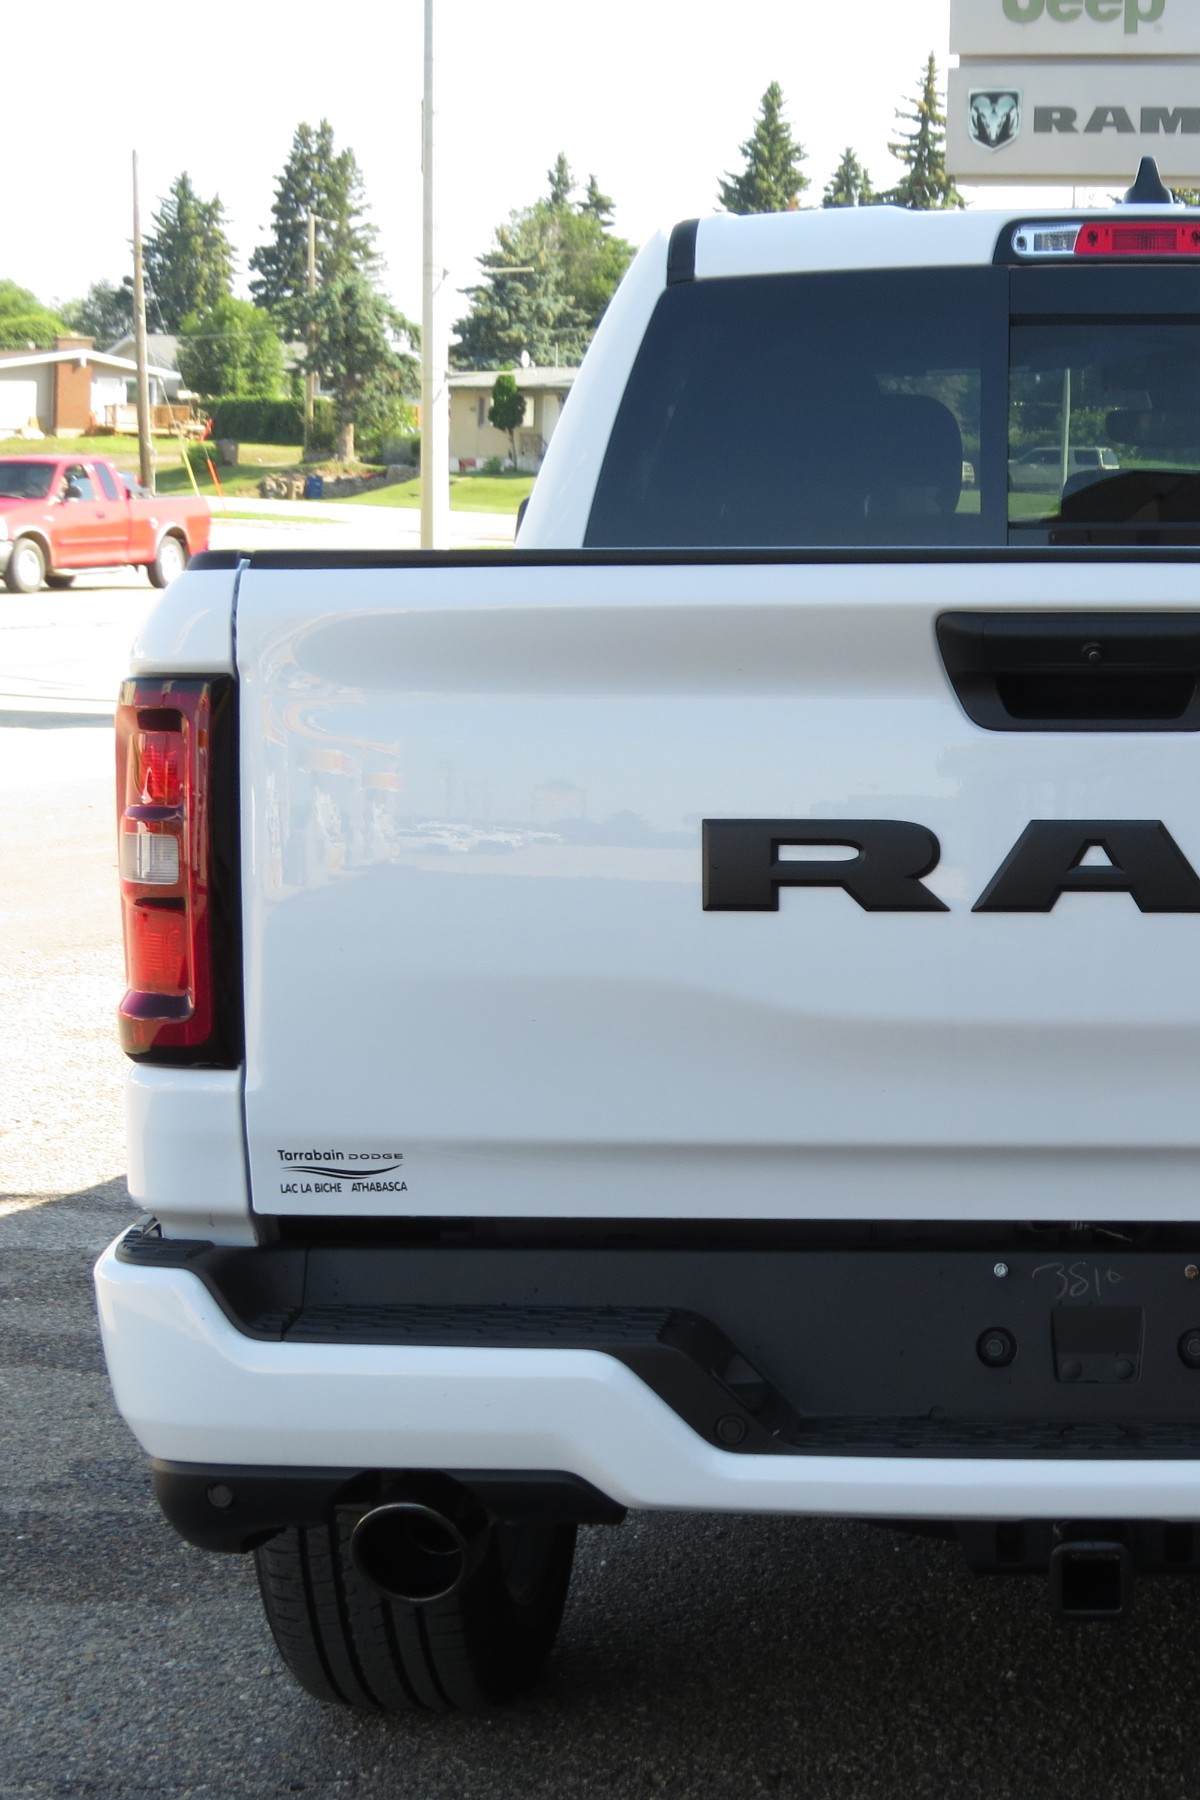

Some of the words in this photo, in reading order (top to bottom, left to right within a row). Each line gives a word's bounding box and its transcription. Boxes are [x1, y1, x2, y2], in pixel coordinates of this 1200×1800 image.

[1033, 106, 1200, 134] RAM
[277, 1149, 344, 1161] Tarrabain
[280, 1183, 299, 1193] LAC
[300, 1183, 312, 1193] LA
[314, 1182, 342, 1193] BICHE
[351, 1181, 408, 1192] ATHABASCA
